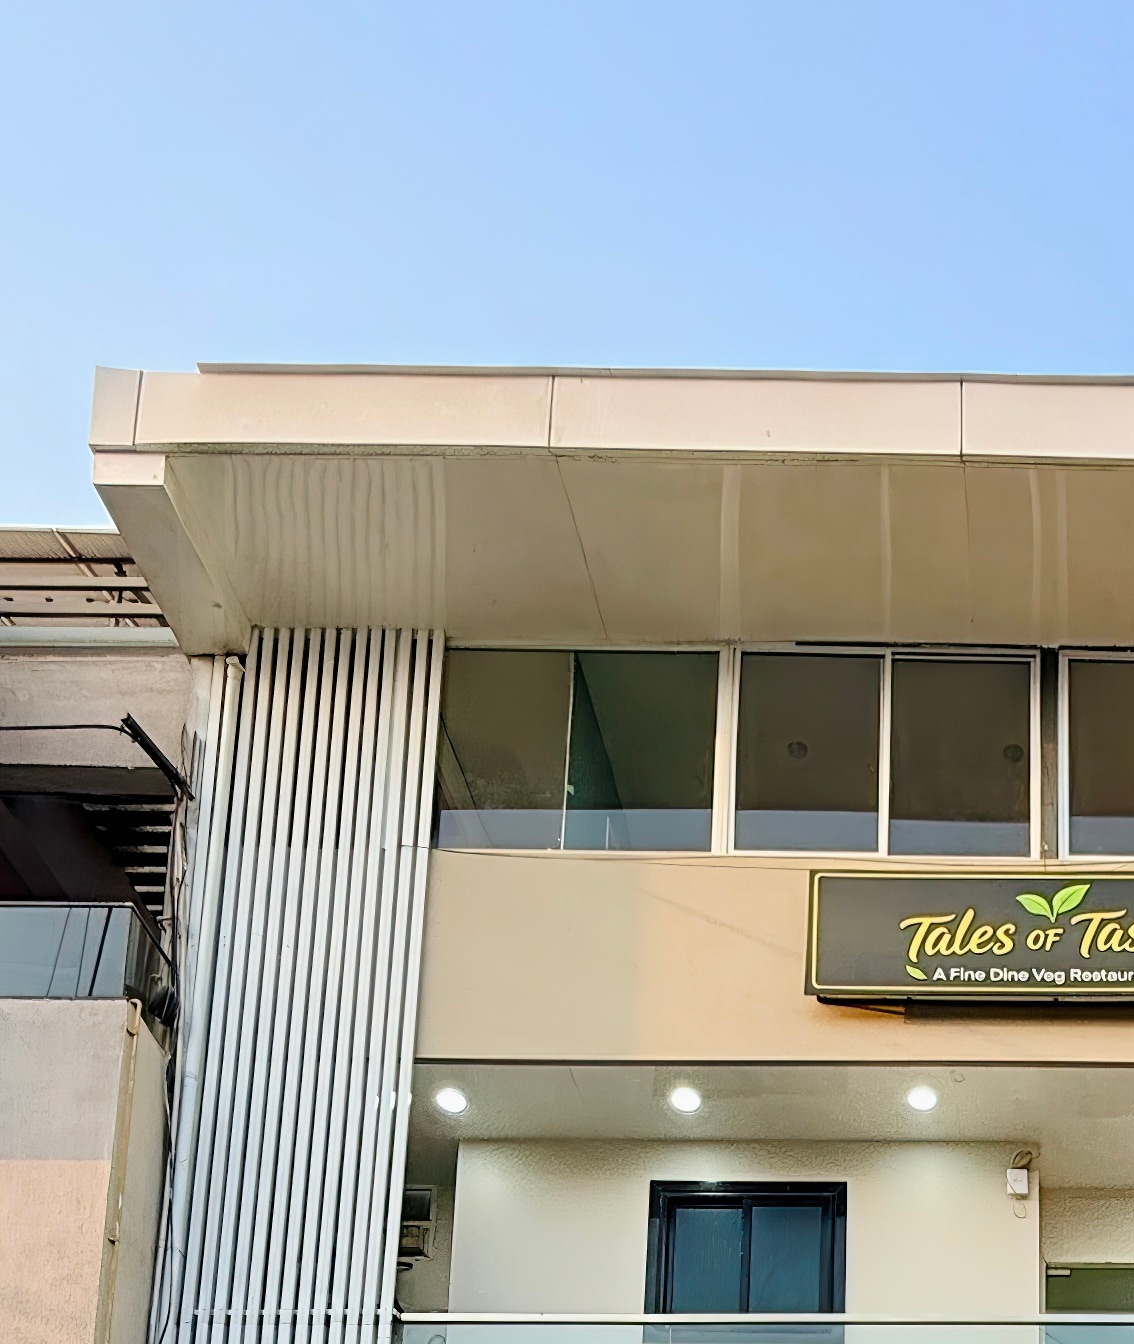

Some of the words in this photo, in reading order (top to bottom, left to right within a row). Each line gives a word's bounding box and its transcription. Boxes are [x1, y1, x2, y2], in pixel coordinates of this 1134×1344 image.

[900, 908, 1015, 963] Tales
[932, 968, 947, 982] A
[949, 968, 986, 982] Fine
[990, 968, 1029, 982] Dine
[1031, 968, 1065, 985] Veg
